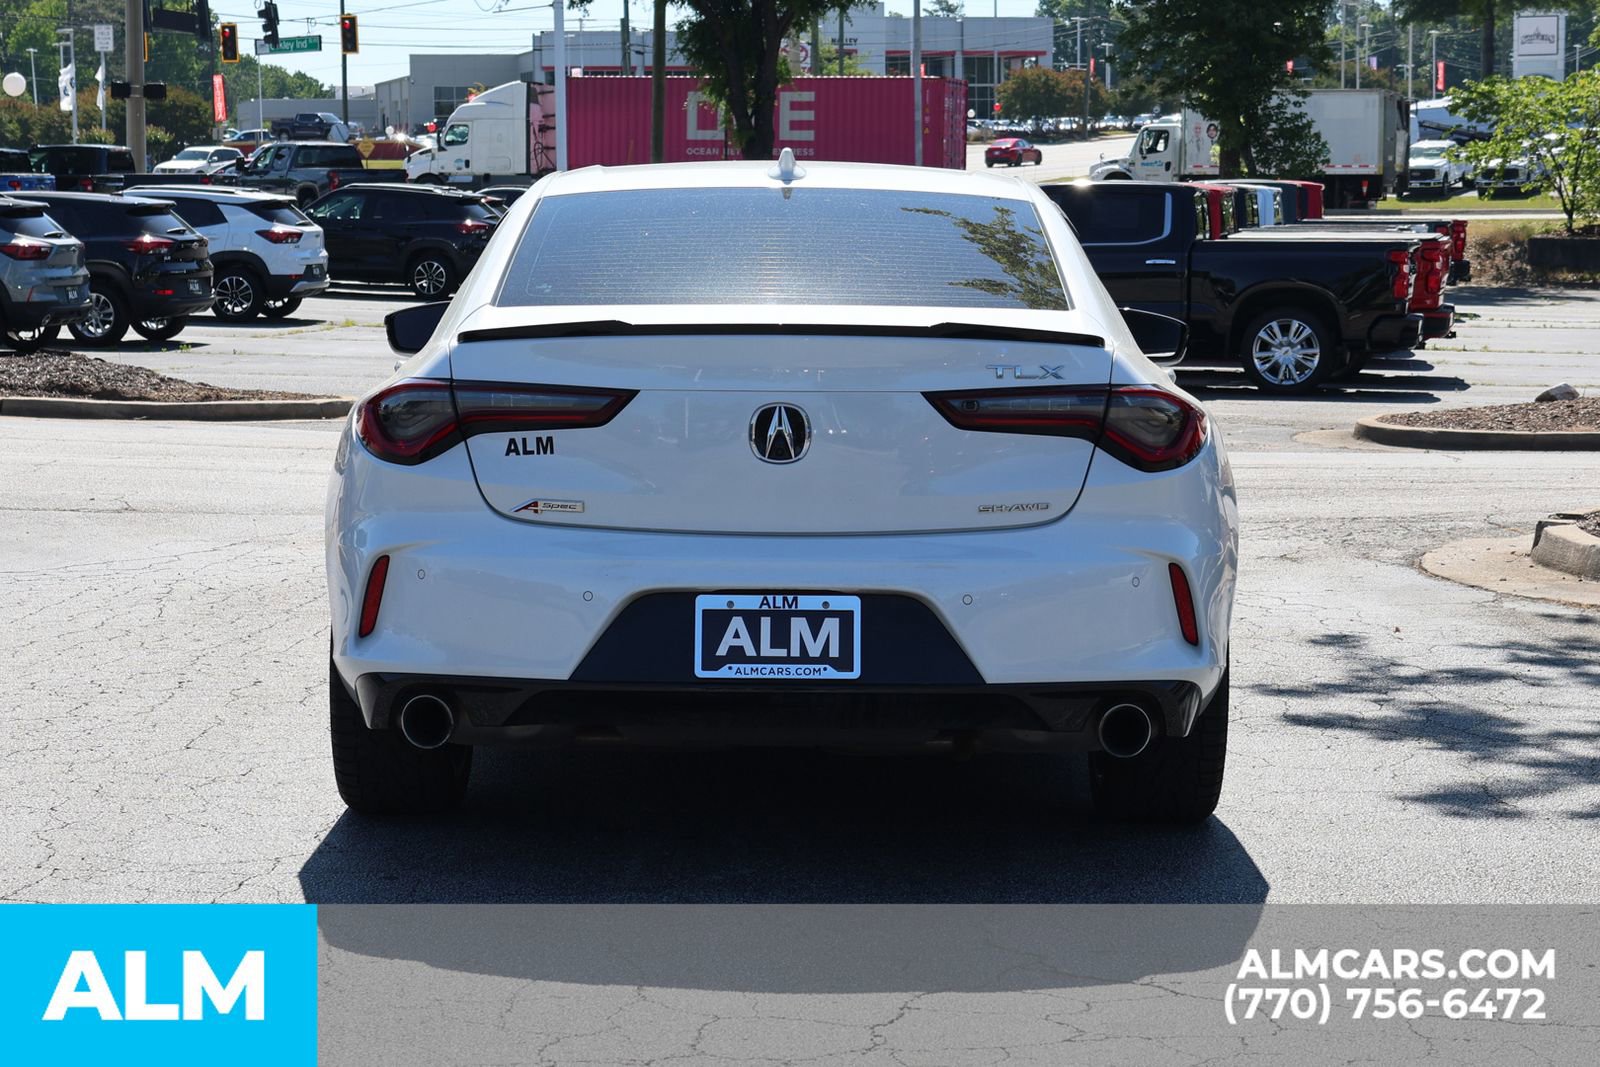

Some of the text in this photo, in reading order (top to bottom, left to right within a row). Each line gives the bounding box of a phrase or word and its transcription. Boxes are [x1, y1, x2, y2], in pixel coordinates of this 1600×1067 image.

[686, 91, 815, 141] OE
[686, 148, 720, 156] OCEAN
[773, 148, 815, 156] EXRESS
[985, 364, 1066, 380] TLX
[504, 436, 555, 457] ALM
[758, 595, 799, 610] ALM
[715, 615, 840, 658] ALM
[734, 666, 822, 676] ALMCARS.COM
